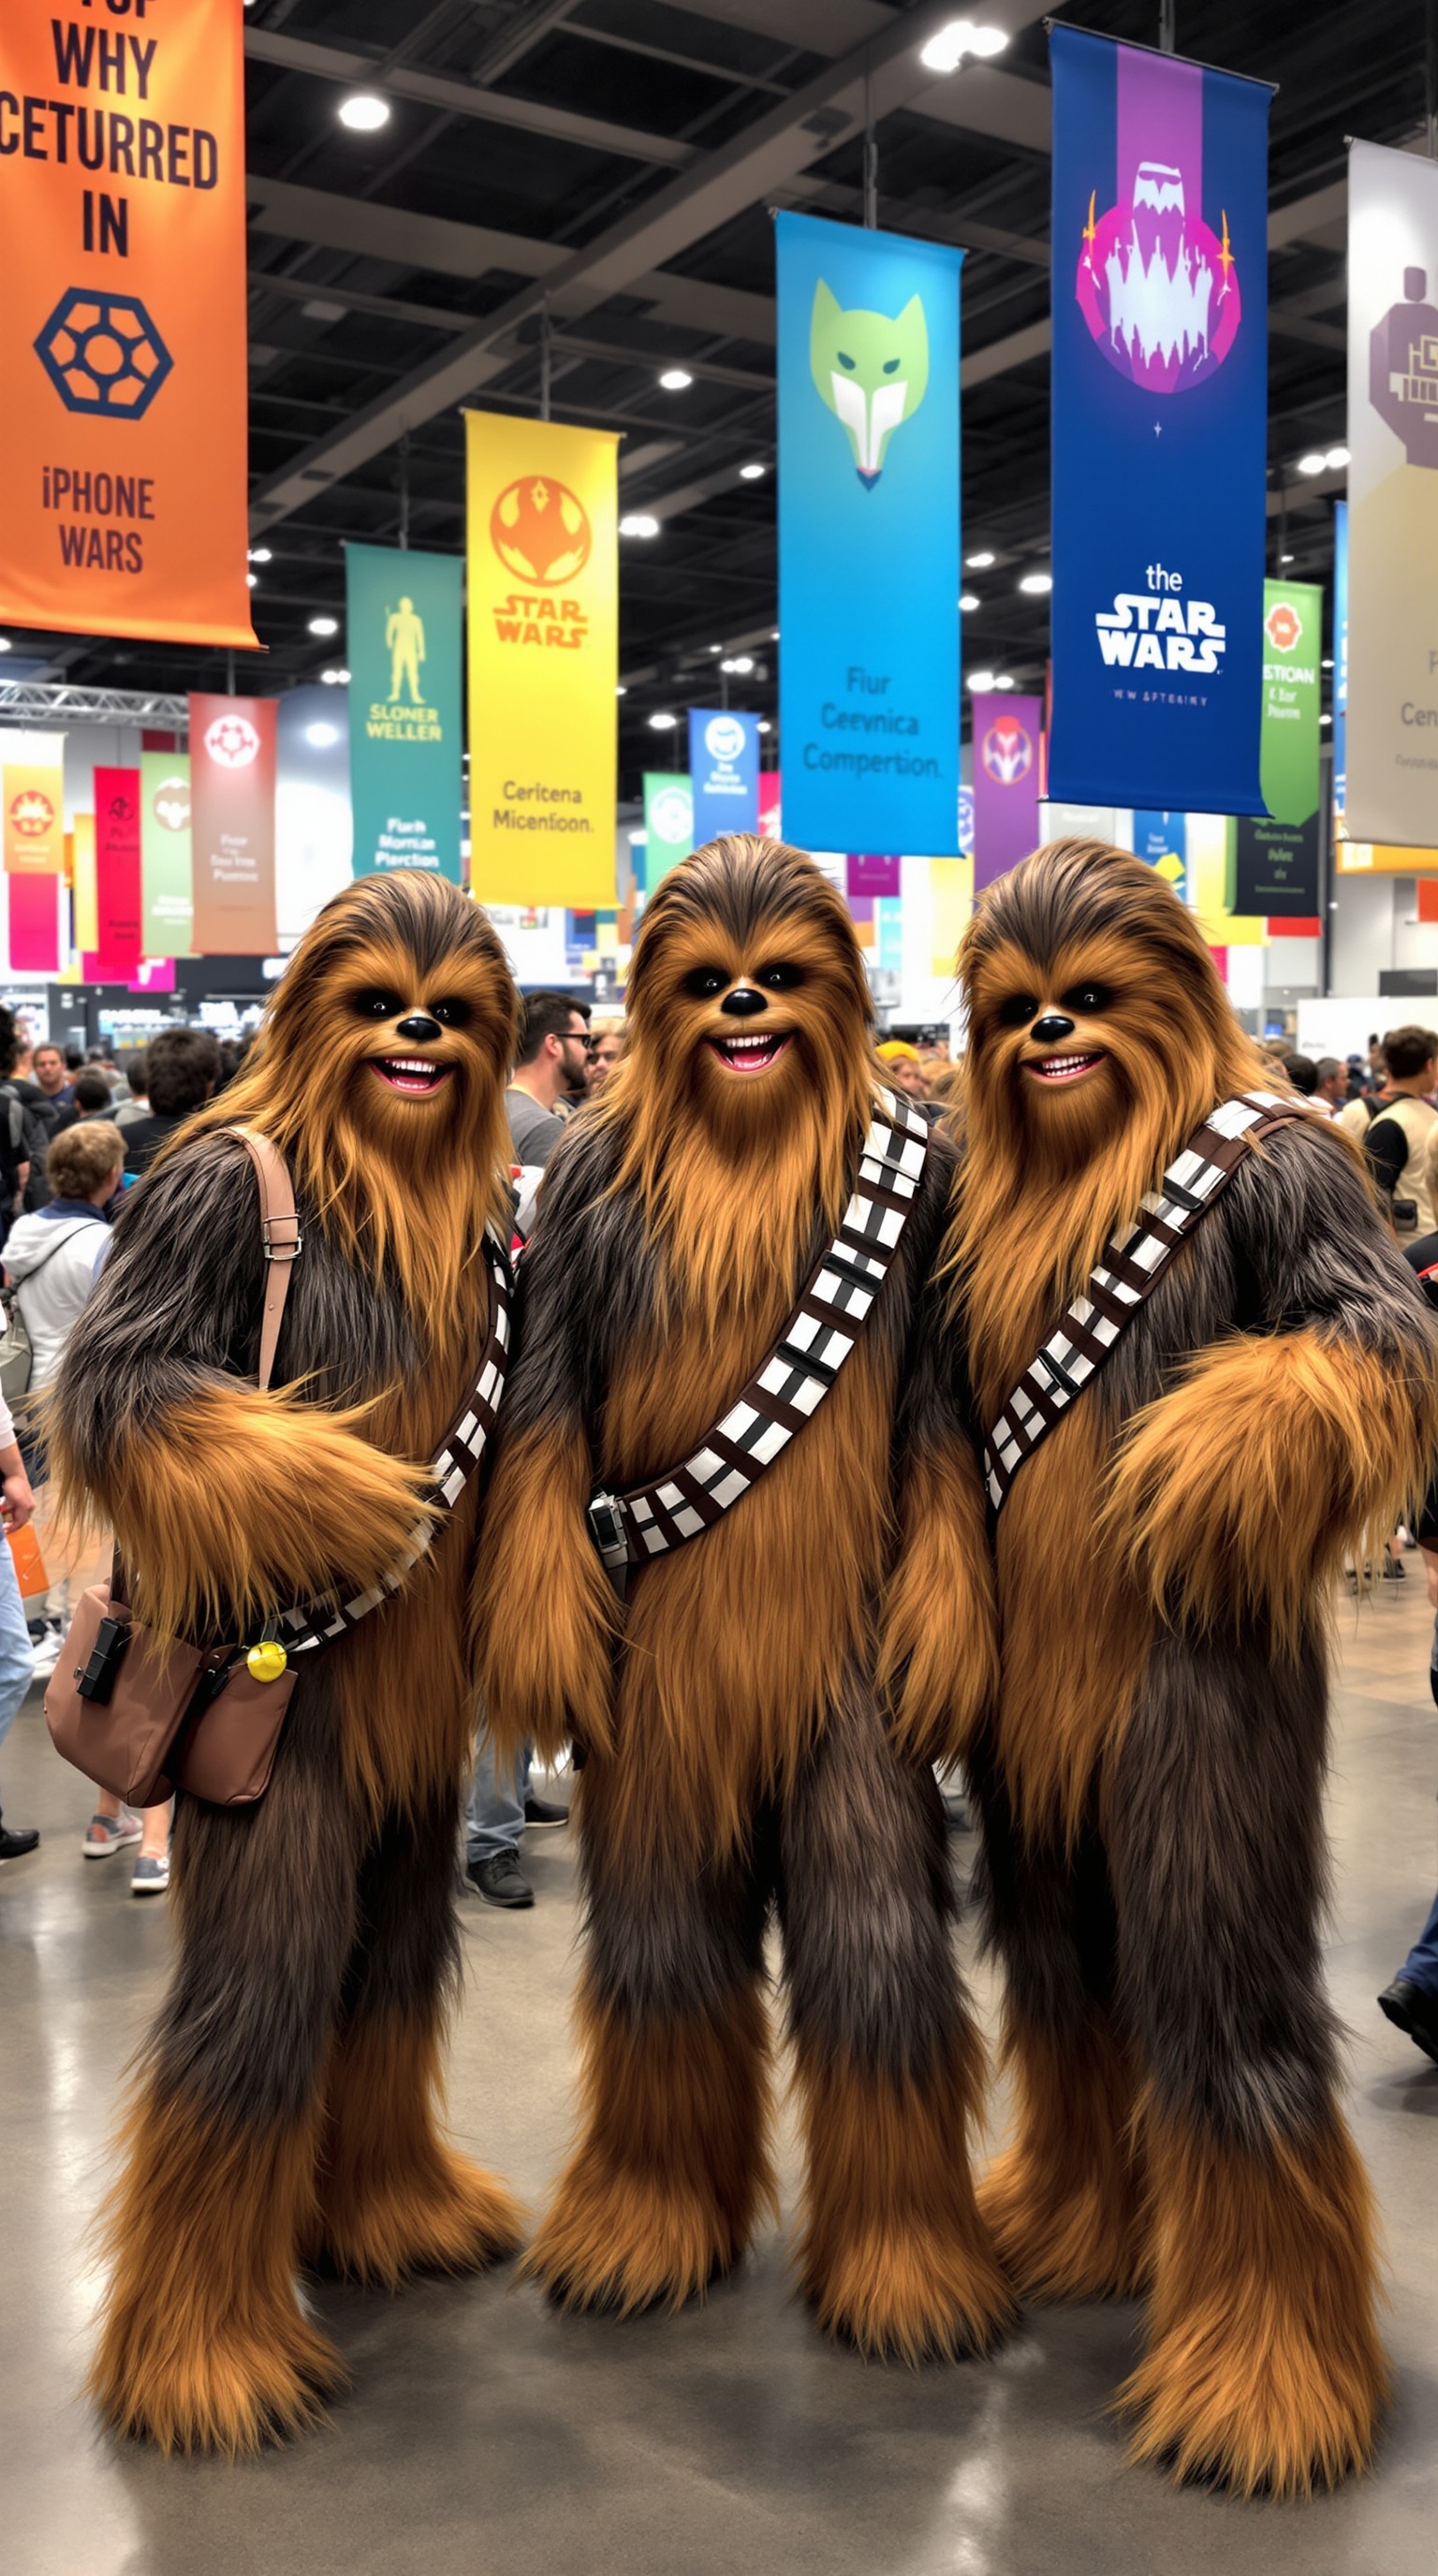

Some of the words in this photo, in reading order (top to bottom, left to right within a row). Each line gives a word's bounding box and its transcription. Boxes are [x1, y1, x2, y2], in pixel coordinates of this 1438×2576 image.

[51, 19, 158, 100] WHY
[83, 190, 128, 257] IN
[43, 466, 155, 520] iPHONE
[59, 524, 143, 575] WARS
[1146, 563, 1182, 592] the
[492, 593, 588, 623] STAR
[1095, 593, 1225, 638] STAR
[494, 619, 588, 649] WARS
[1096, 628, 1225, 674] WARS
[366, 720, 442, 742] WELLER
